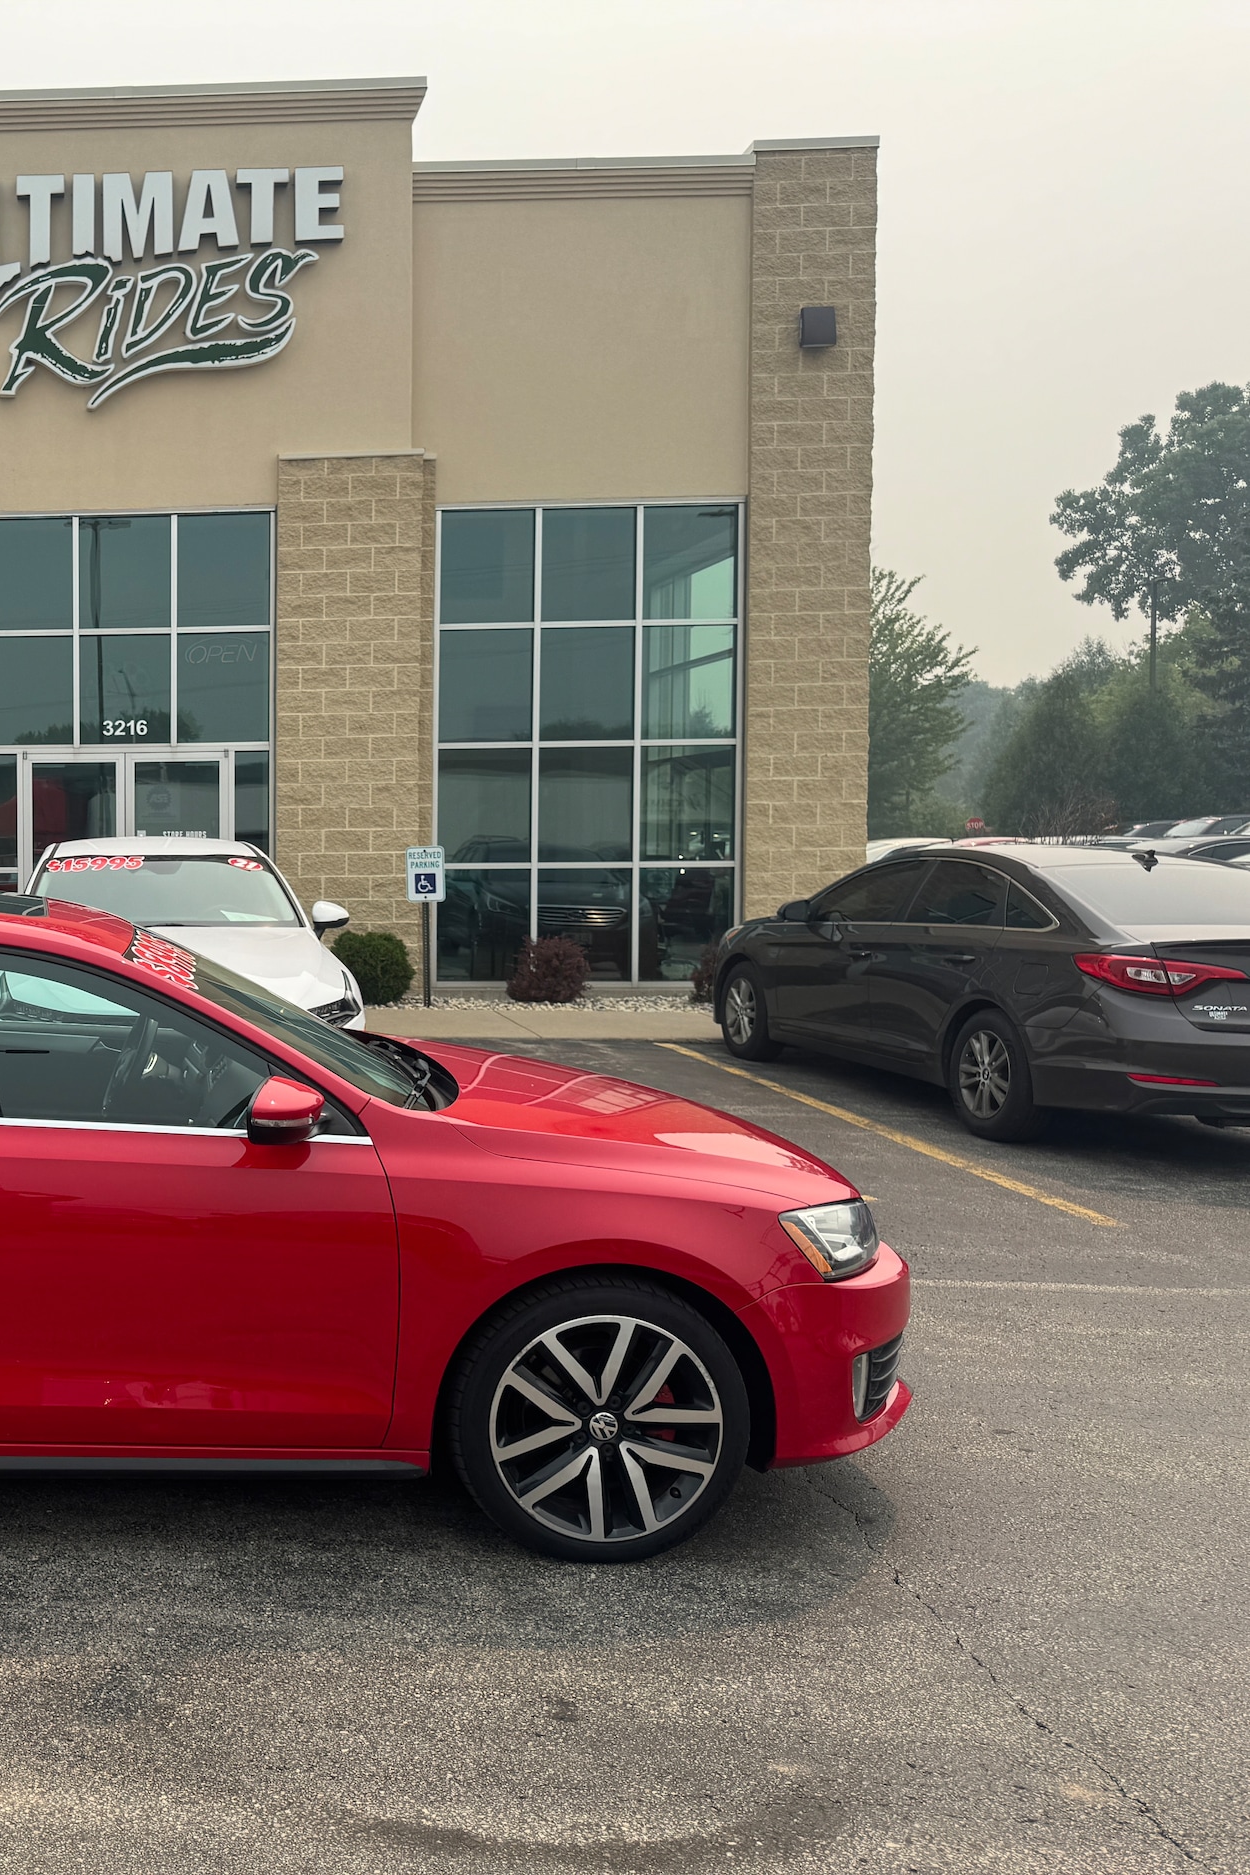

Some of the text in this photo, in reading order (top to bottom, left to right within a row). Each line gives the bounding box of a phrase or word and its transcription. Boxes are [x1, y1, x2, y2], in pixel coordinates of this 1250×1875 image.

[188, 644, 258, 664] OPEN
[102, 719, 148, 736] 3216
[966, 821, 984, 830] STOP
[408, 851, 441, 860] RESERVED
[46, 856, 145, 873] $15995
[410, 860, 440, 869] PARKING
